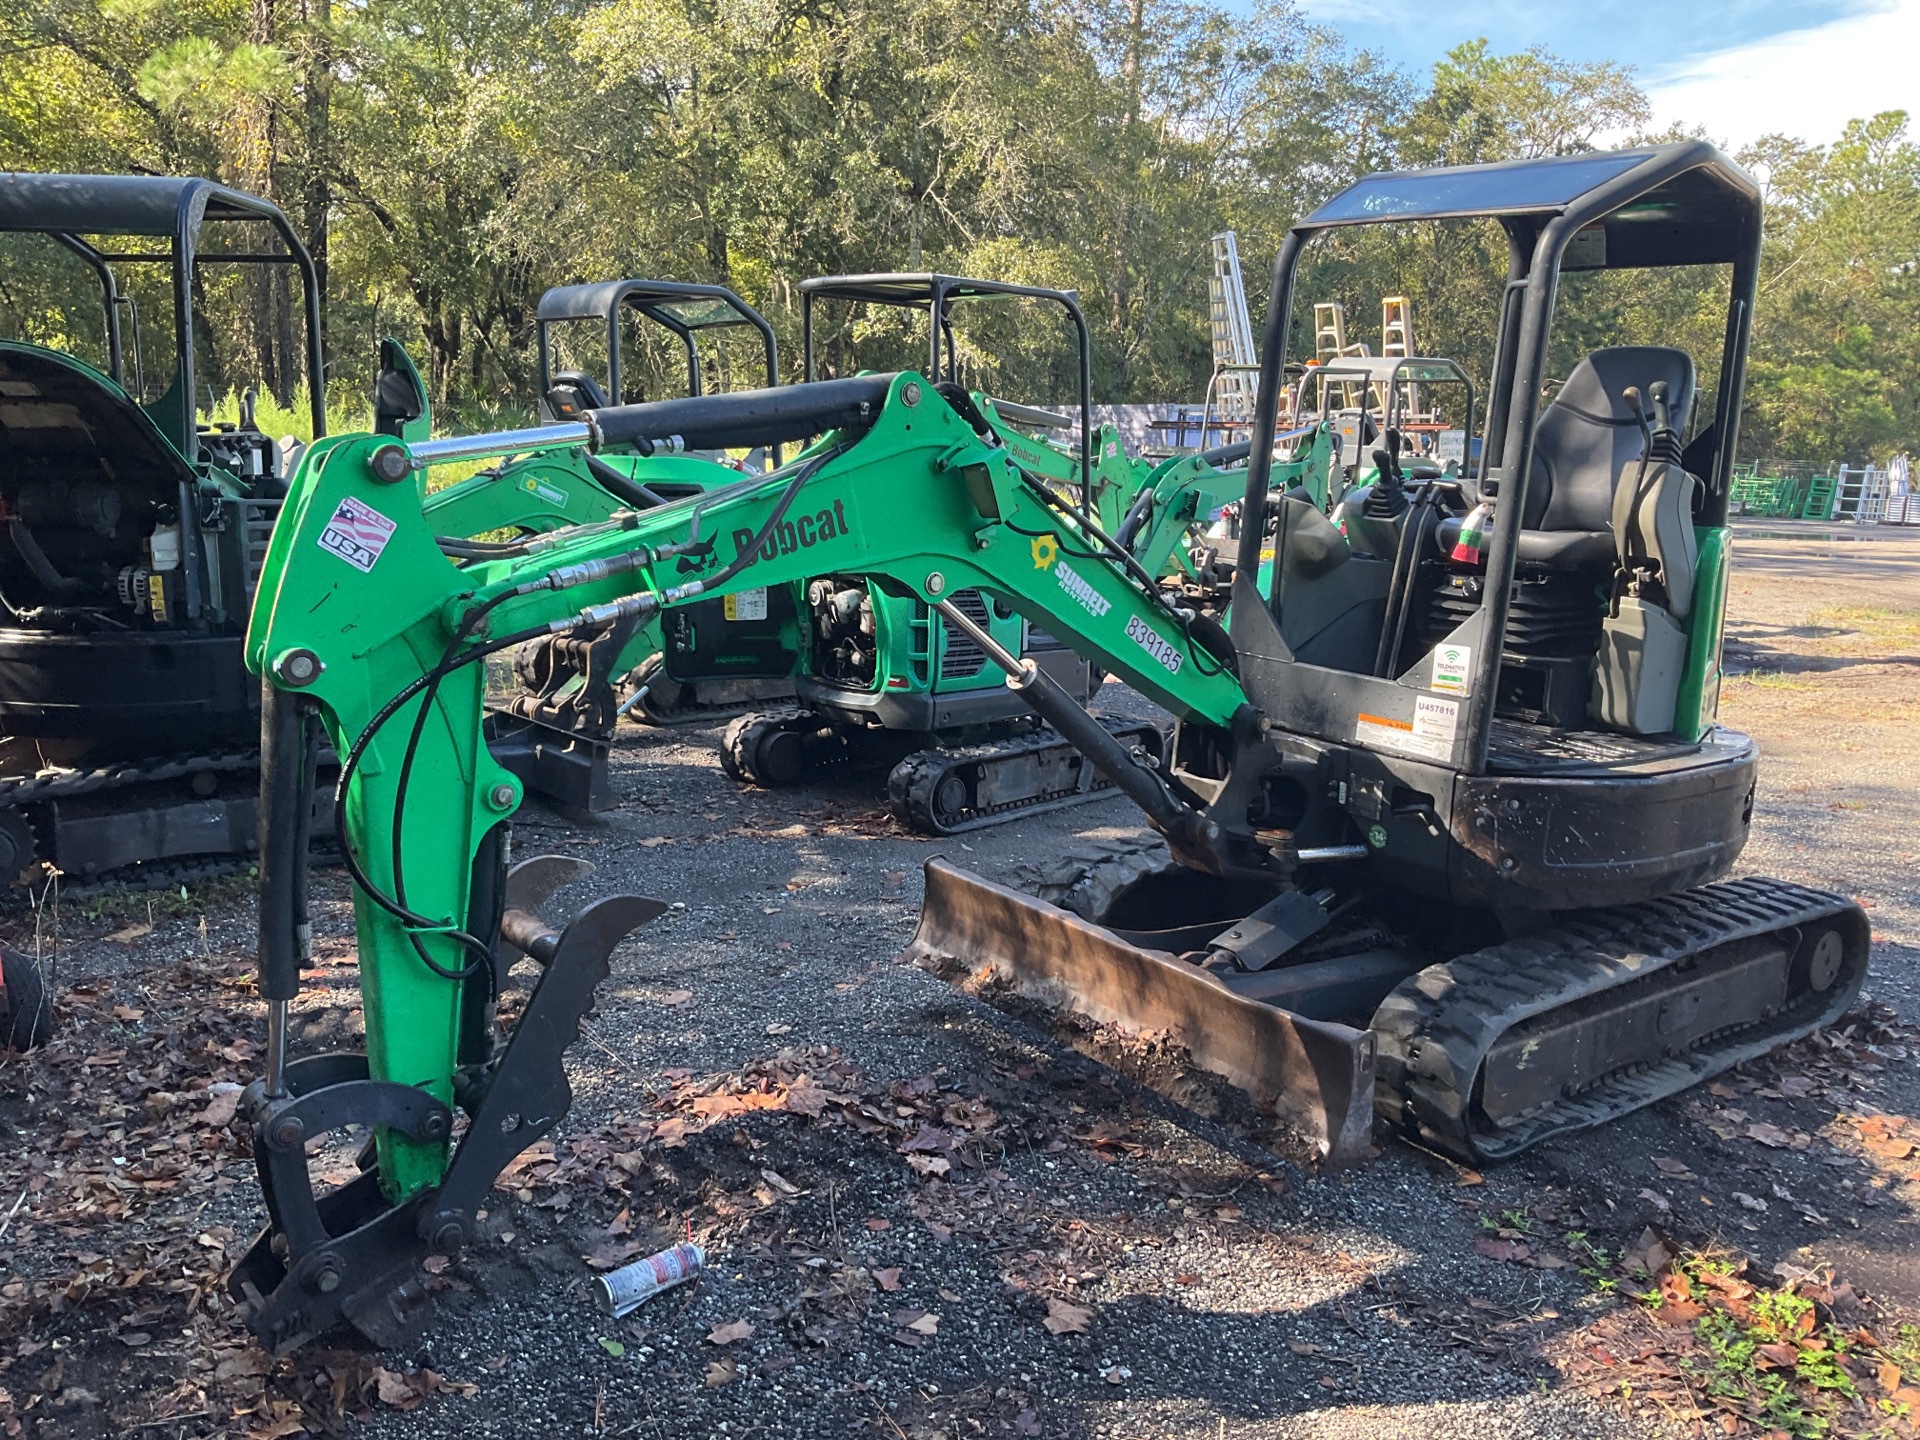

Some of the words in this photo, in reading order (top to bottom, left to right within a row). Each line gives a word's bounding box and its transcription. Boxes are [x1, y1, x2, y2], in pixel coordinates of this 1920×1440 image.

[1011, 443, 1041, 467] Bobcat
[1440, 437, 1464, 445] EQUIPMEN
[346, 498, 369, 515] MADE
[368, 511, 378, 521] IN
[378, 517, 392, 530] THE
[324, 529, 371, 566] USA
[731, 498, 849, 567] Bobcat
[1054, 560, 1112, 617] SUNBELT
[1057, 580, 1099, 617] RENTALS
[1126, 617, 1182, 672] 839185
[1394, 720, 1413, 732] WARN
[1418, 702, 1455, 716] U457816
